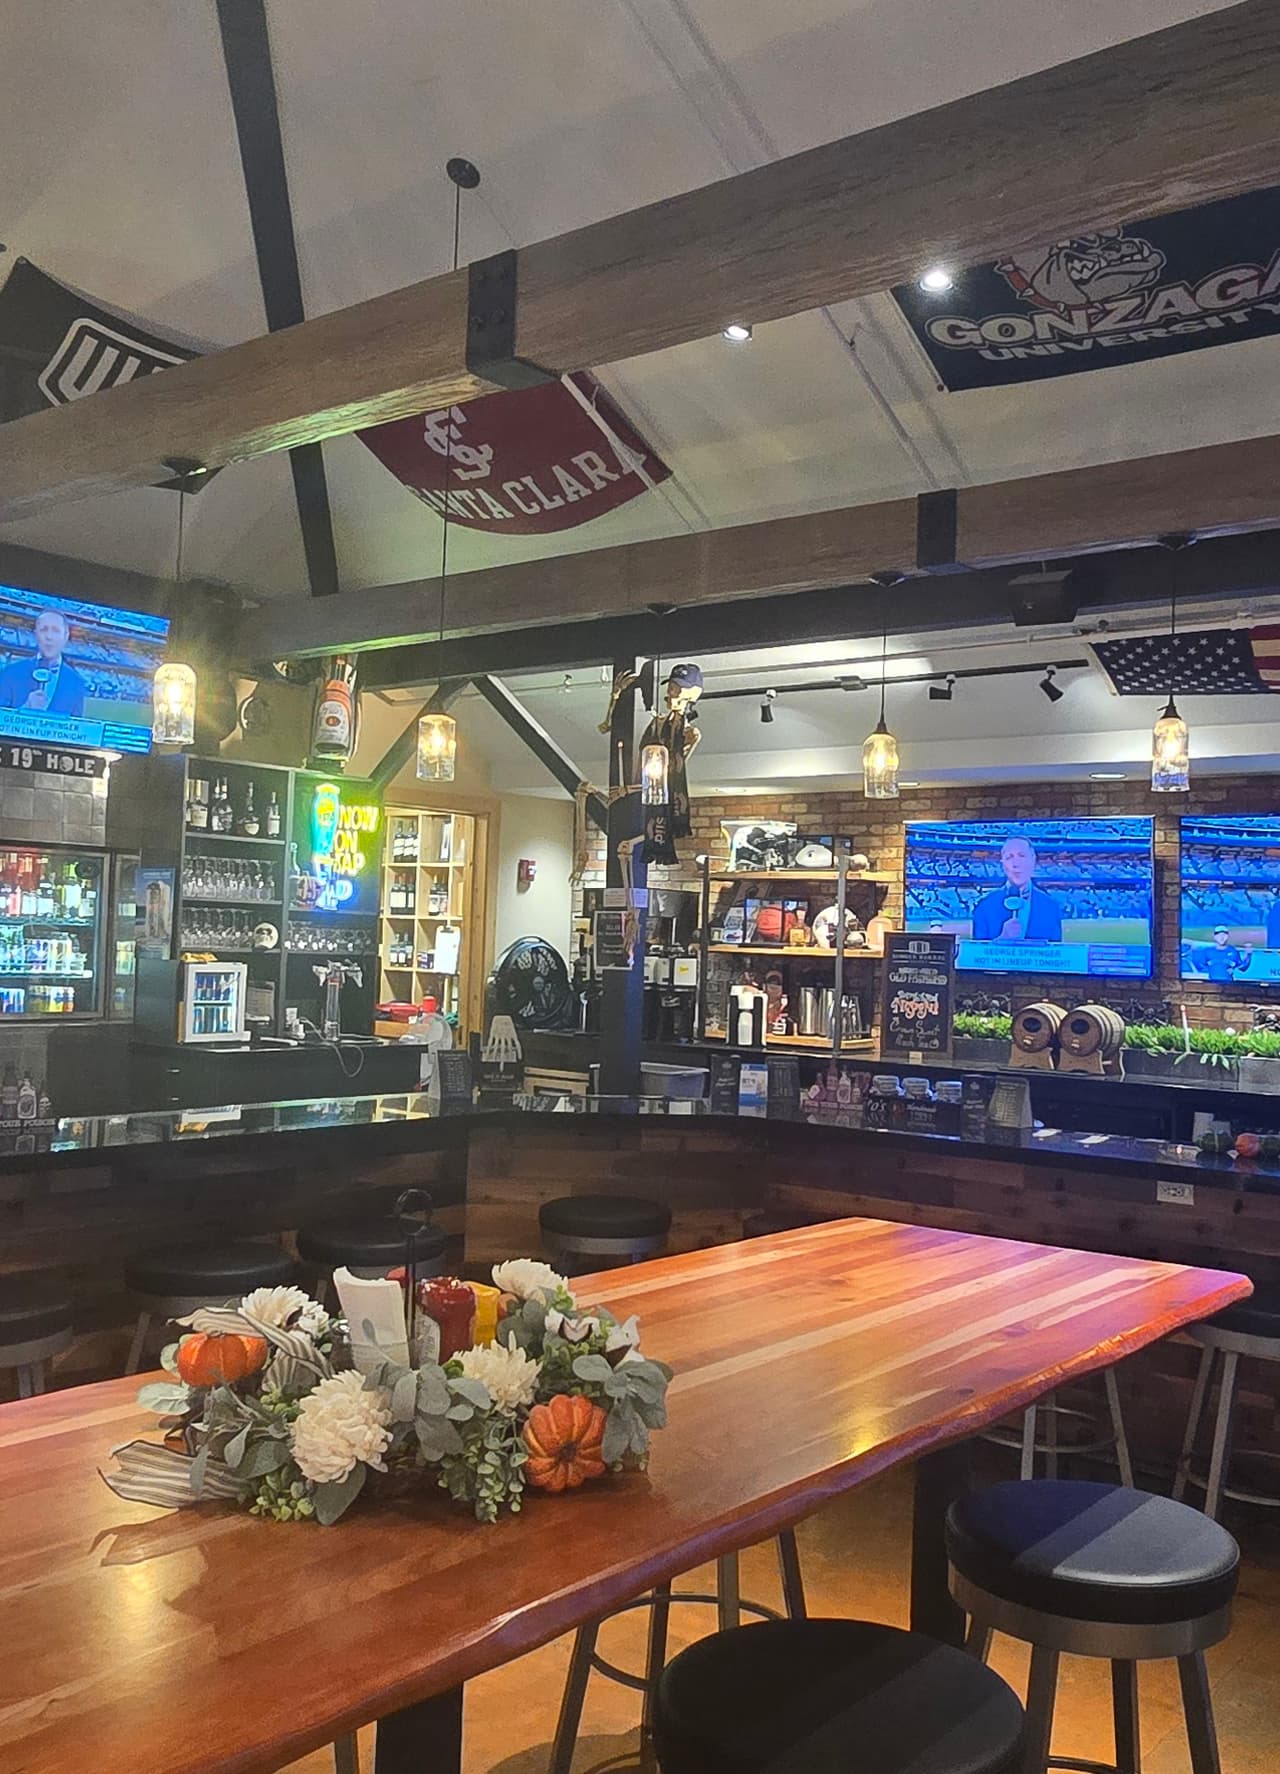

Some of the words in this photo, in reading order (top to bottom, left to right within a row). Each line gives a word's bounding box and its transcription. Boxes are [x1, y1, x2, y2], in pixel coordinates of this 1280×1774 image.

[46, 752, 96, 774] HOLE
[339, 805, 379, 832] NOW
[334, 830, 359, 853] ON
[333, 852, 366, 876] TAP
